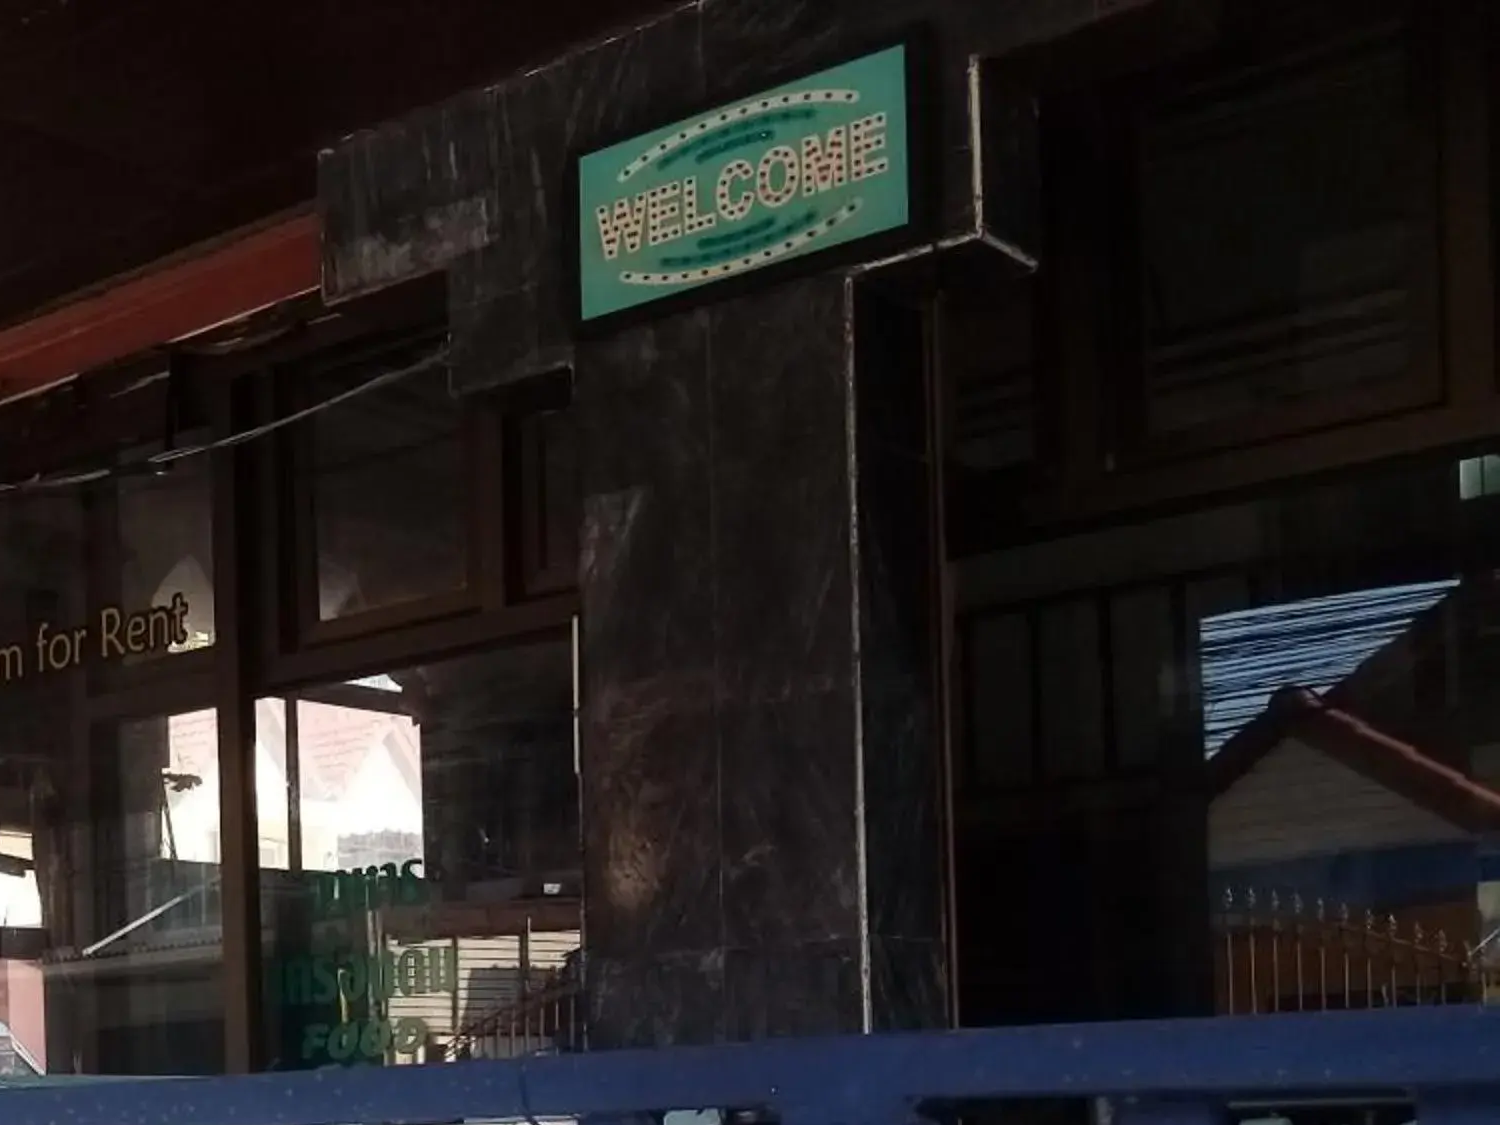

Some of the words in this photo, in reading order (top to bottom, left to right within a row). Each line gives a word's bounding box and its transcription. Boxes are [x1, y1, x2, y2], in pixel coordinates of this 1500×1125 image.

[595, 111, 889, 261] WELCOME
[36, 622, 88, 672] for
[101, 591, 189, 658] Rent
[302, 1016, 428, 1060] FOOD
